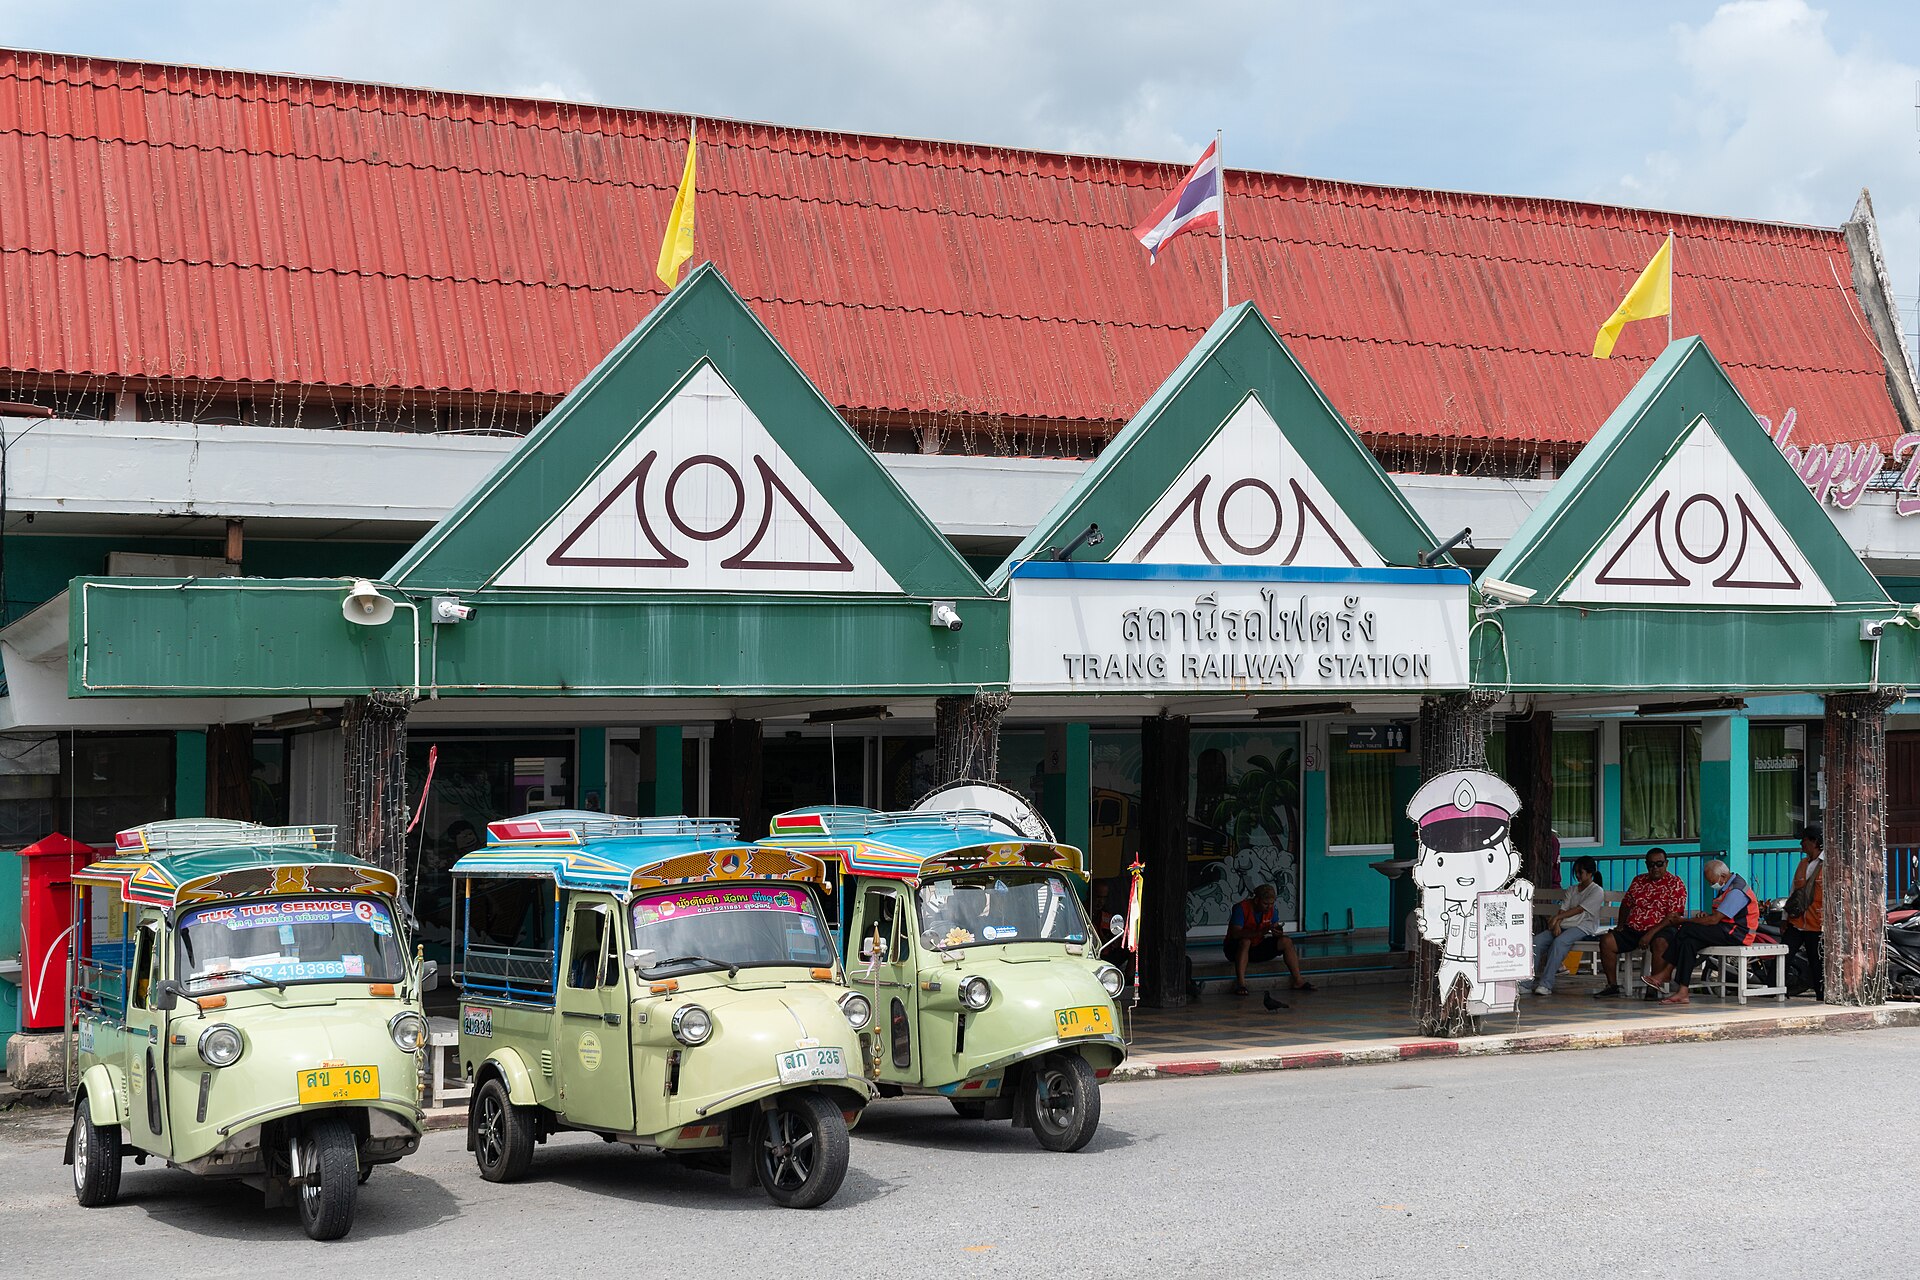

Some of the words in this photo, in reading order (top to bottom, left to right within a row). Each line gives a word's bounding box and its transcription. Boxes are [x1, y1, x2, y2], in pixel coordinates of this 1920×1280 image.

[1121, 587, 1376, 642] สถานีรถไฟตรัง
[1063, 653, 1167, 679] TRANG
[1182, 653, 1304, 679] RAILWAY
[1318, 653, 1431, 678] STATION
[198, 908, 234, 923] TUK
[240, 904, 277, 917] TUK
[281, 901, 353, 914] SERVICE
[358, 903, 373, 921] 3
[1507, 943, 1527, 958] 3D
[307, 962, 343, 974] 3363
[1059, 1010, 1079, 1025] สก
[1092, 1008, 1100, 1022] 5
[474, 1019, 492, 1036] 334
[785, 1052, 807, 1069] สก
[817, 1050, 840, 1064] 235
[344, 1069, 371, 1084] 160
[333, 1088, 348, 1098] ตรัง
